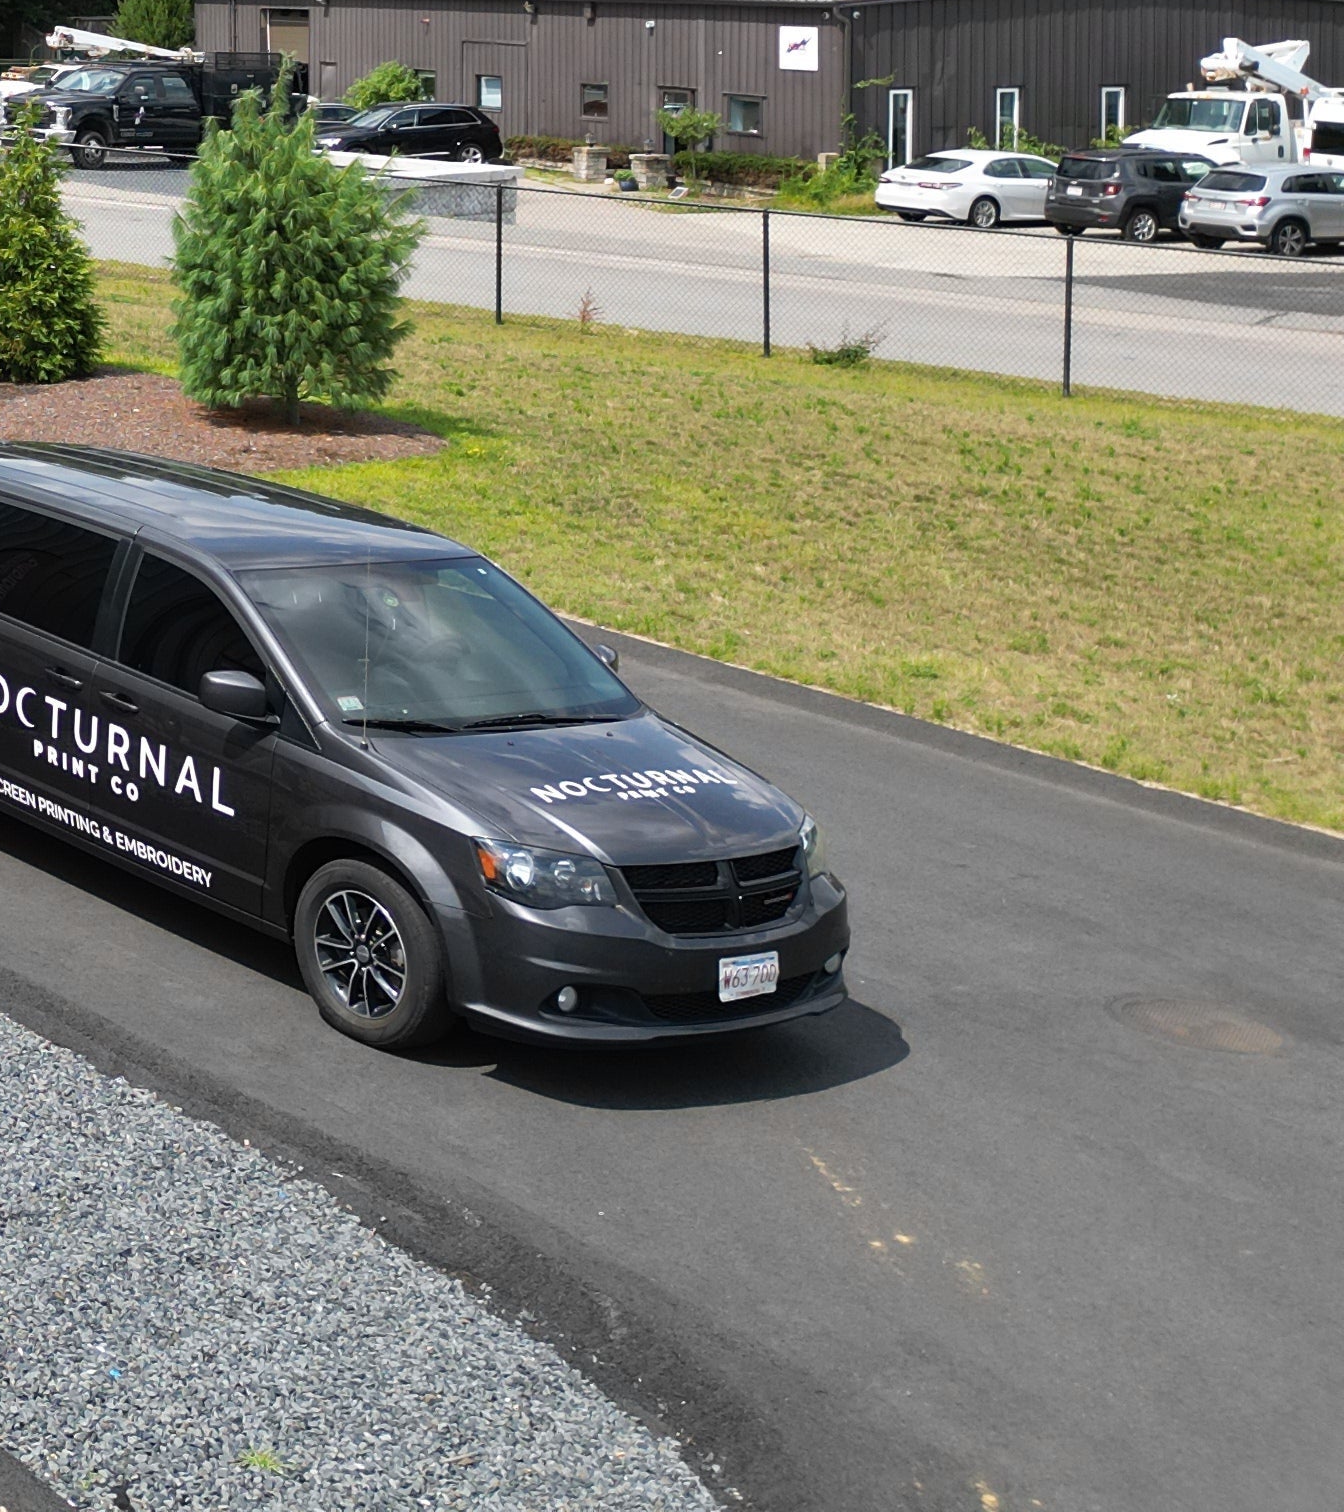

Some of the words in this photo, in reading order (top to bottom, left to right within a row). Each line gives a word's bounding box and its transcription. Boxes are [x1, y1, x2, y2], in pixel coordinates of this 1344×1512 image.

[33, 739, 99, 784] PRINT
[111, 775, 139, 802] CO
[530, 769, 738, 804] NOCTURNAL
[672, 785, 697, 795] CO
[38, 796, 101, 838] PRINTING
[102, 825, 114, 845] &
[115, 832, 212, 888] EMBROIDERY
